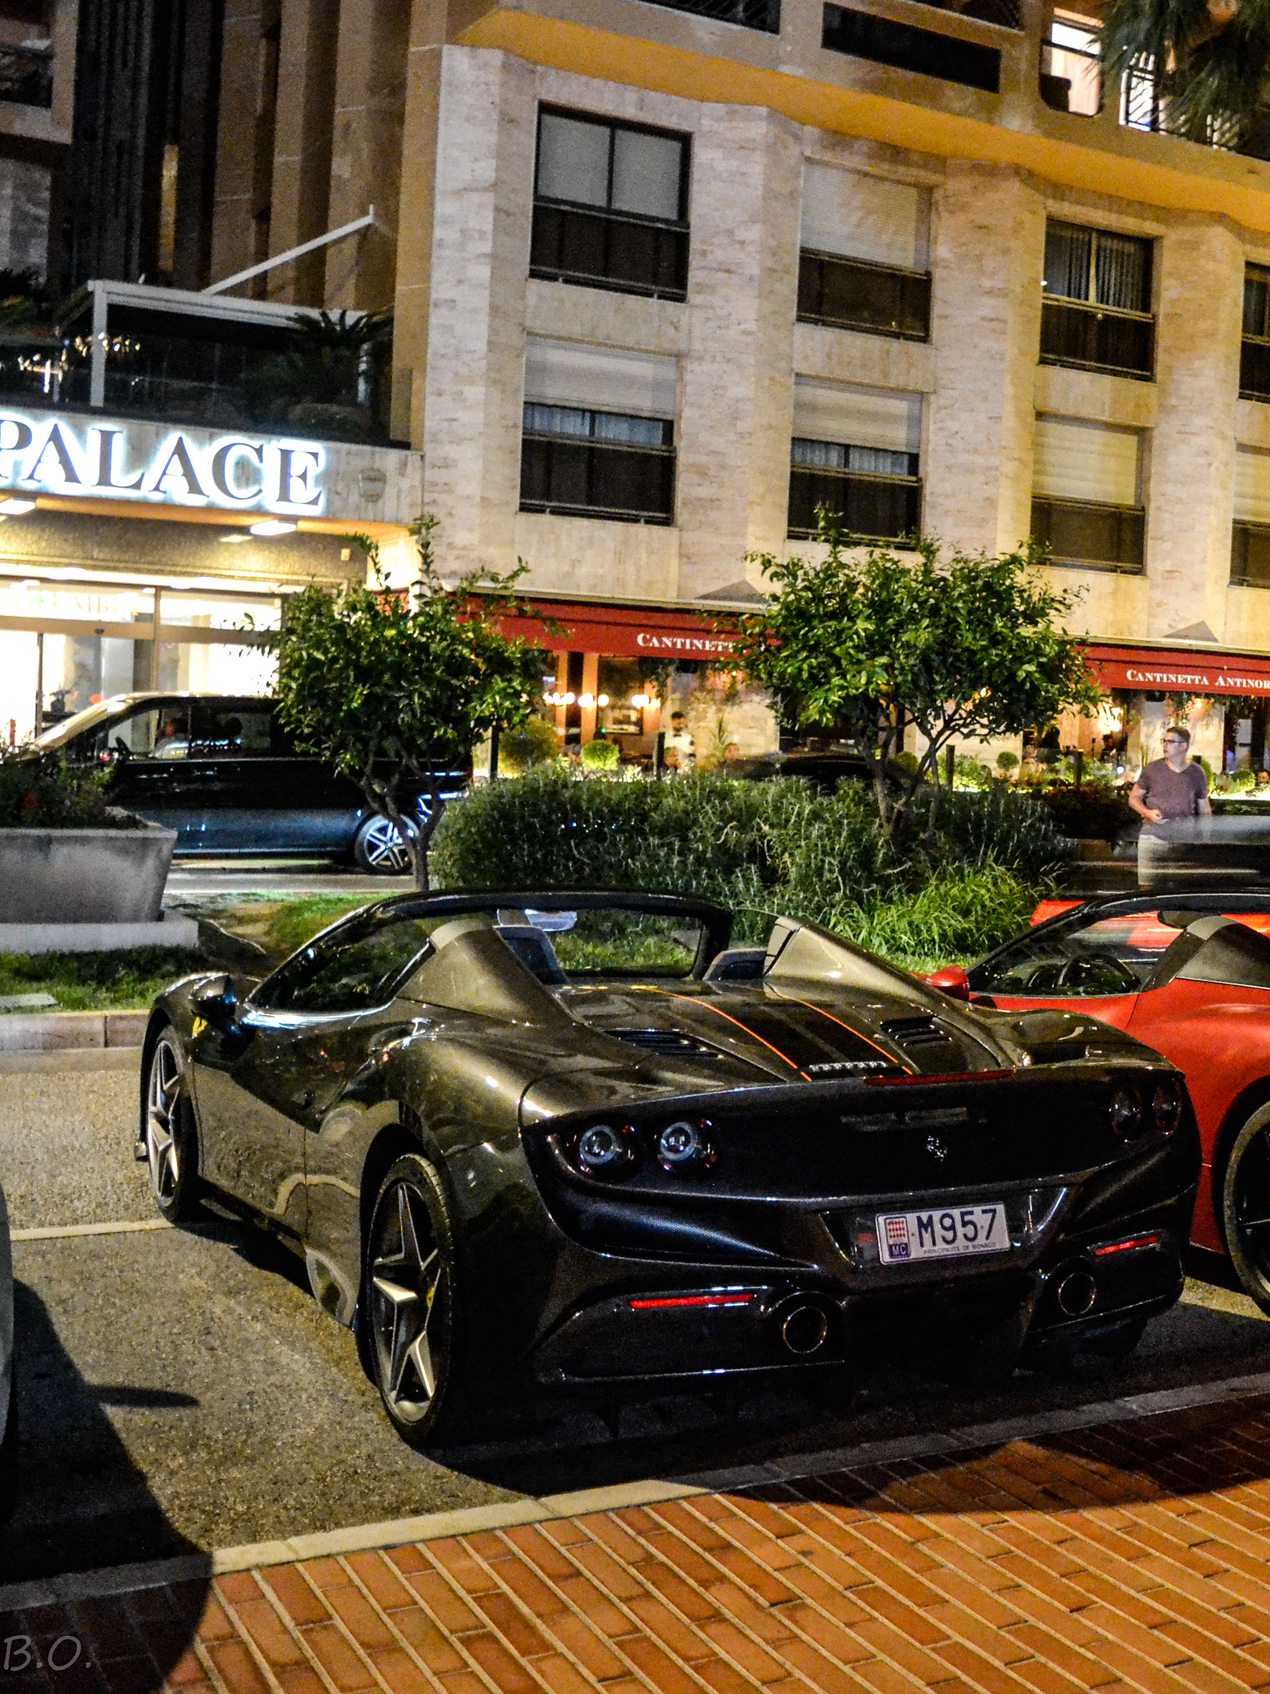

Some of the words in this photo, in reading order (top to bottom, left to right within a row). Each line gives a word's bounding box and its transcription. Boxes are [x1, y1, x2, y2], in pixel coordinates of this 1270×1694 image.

[0, 418, 324, 507] PALACE
[636, 632, 738, 653] CANTINETT
[1126, 669, 1209, 686] CANTINETTA
[916, 1208, 997, 1248] M957
[892, 1244, 907, 1256] MC
